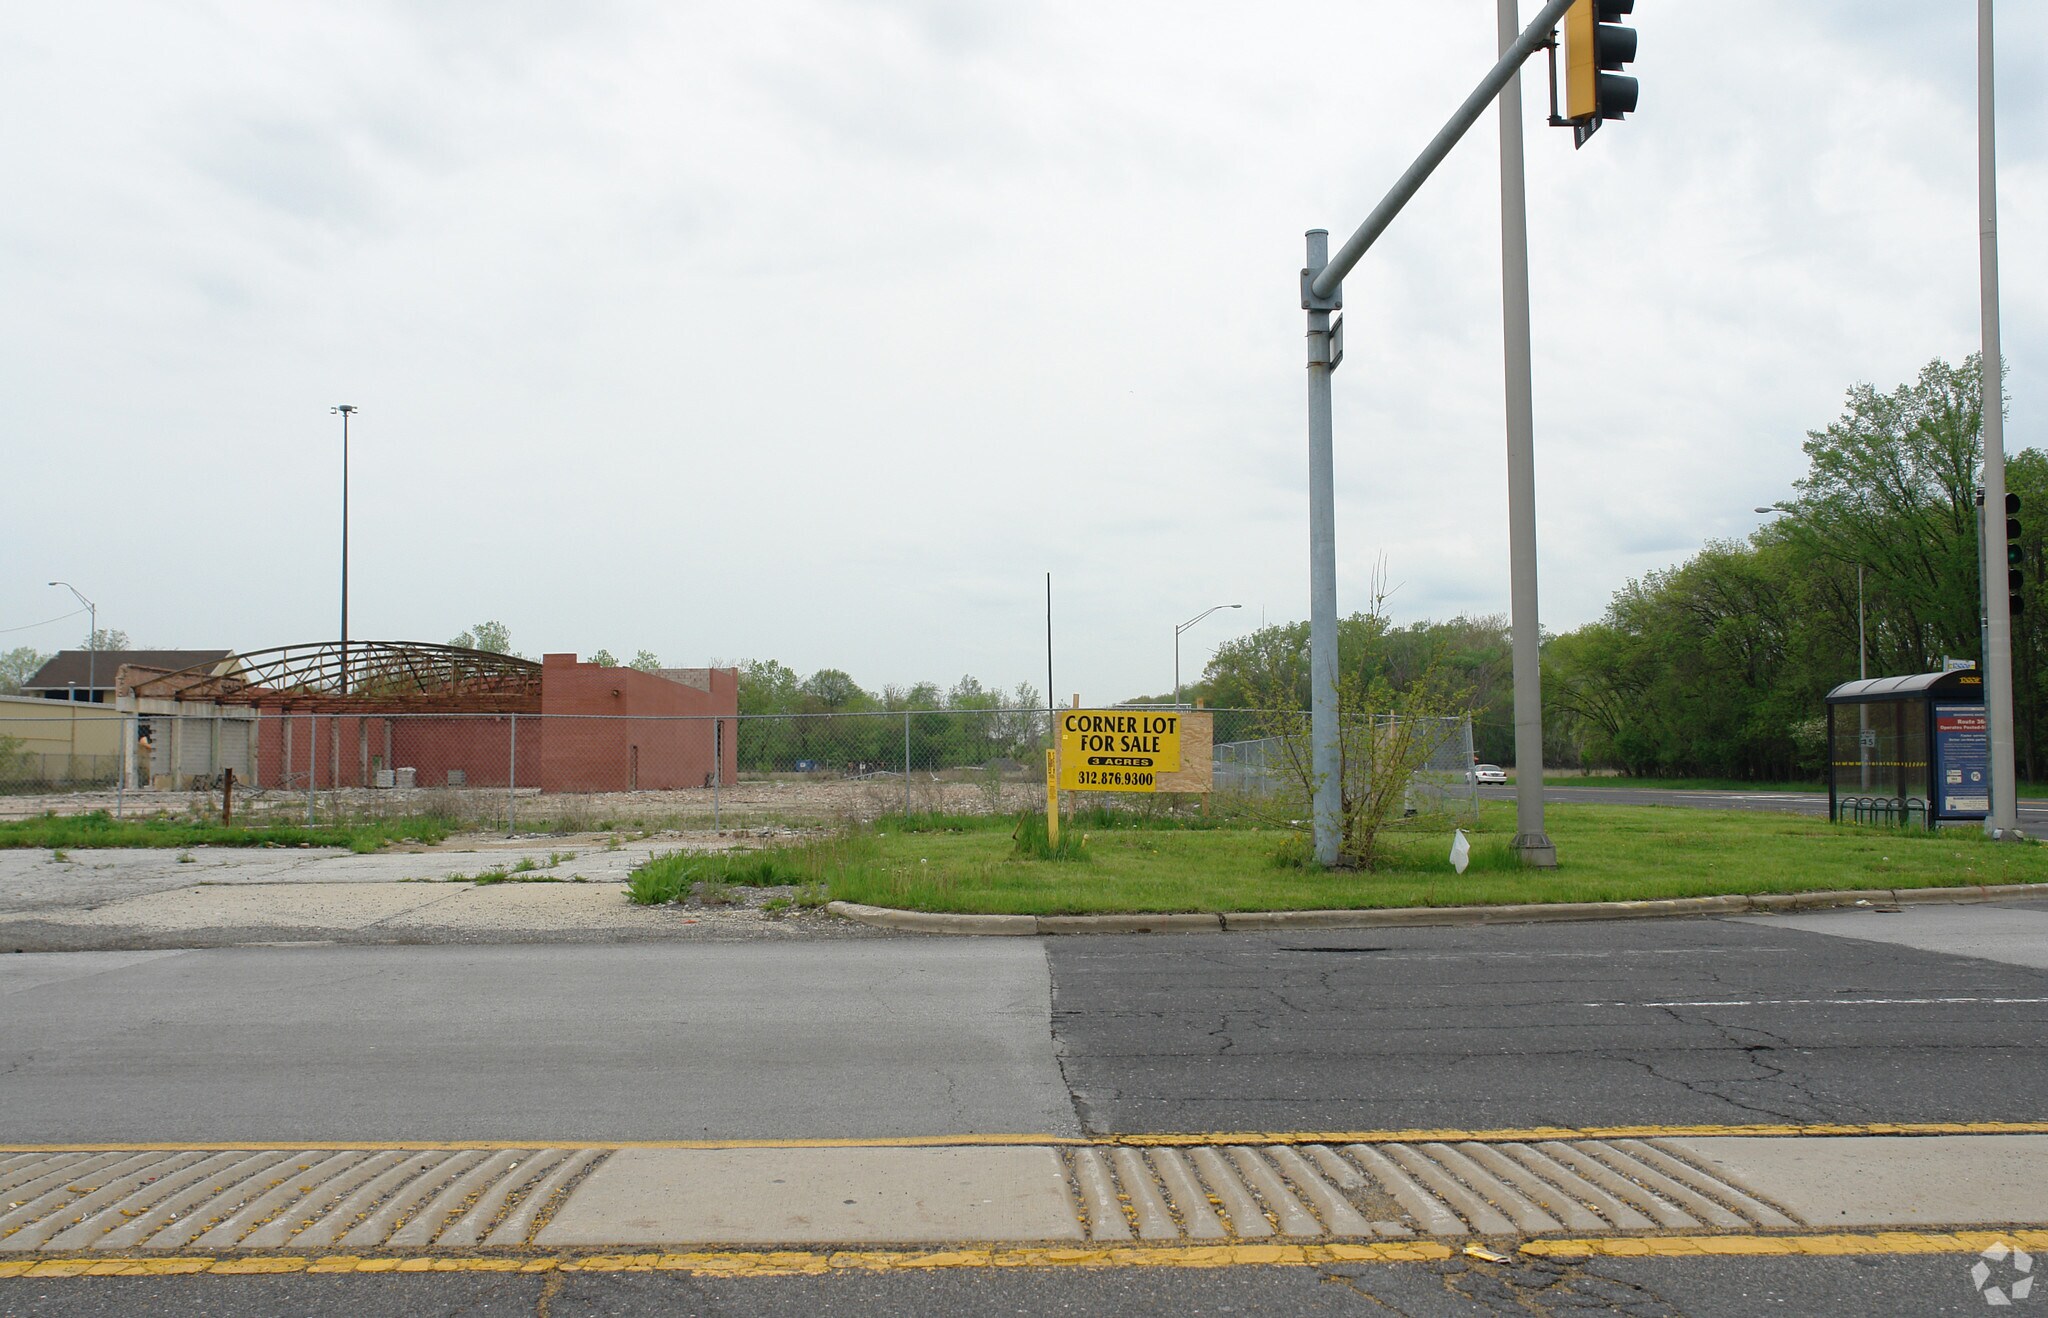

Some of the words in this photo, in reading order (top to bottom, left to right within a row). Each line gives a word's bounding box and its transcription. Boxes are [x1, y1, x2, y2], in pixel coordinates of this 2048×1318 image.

[1065, 715, 1137, 733] CORNER
[1143, 717, 1177, 734] LOT
[1080, 735, 1114, 752] FOR
[1121, 735, 1161, 753] SALE
[1092, 757, 1100, 765] 3
[1105, 758, 1149, 766] ACRES
[1078, 771, 1153, 786] 312.876.9300
